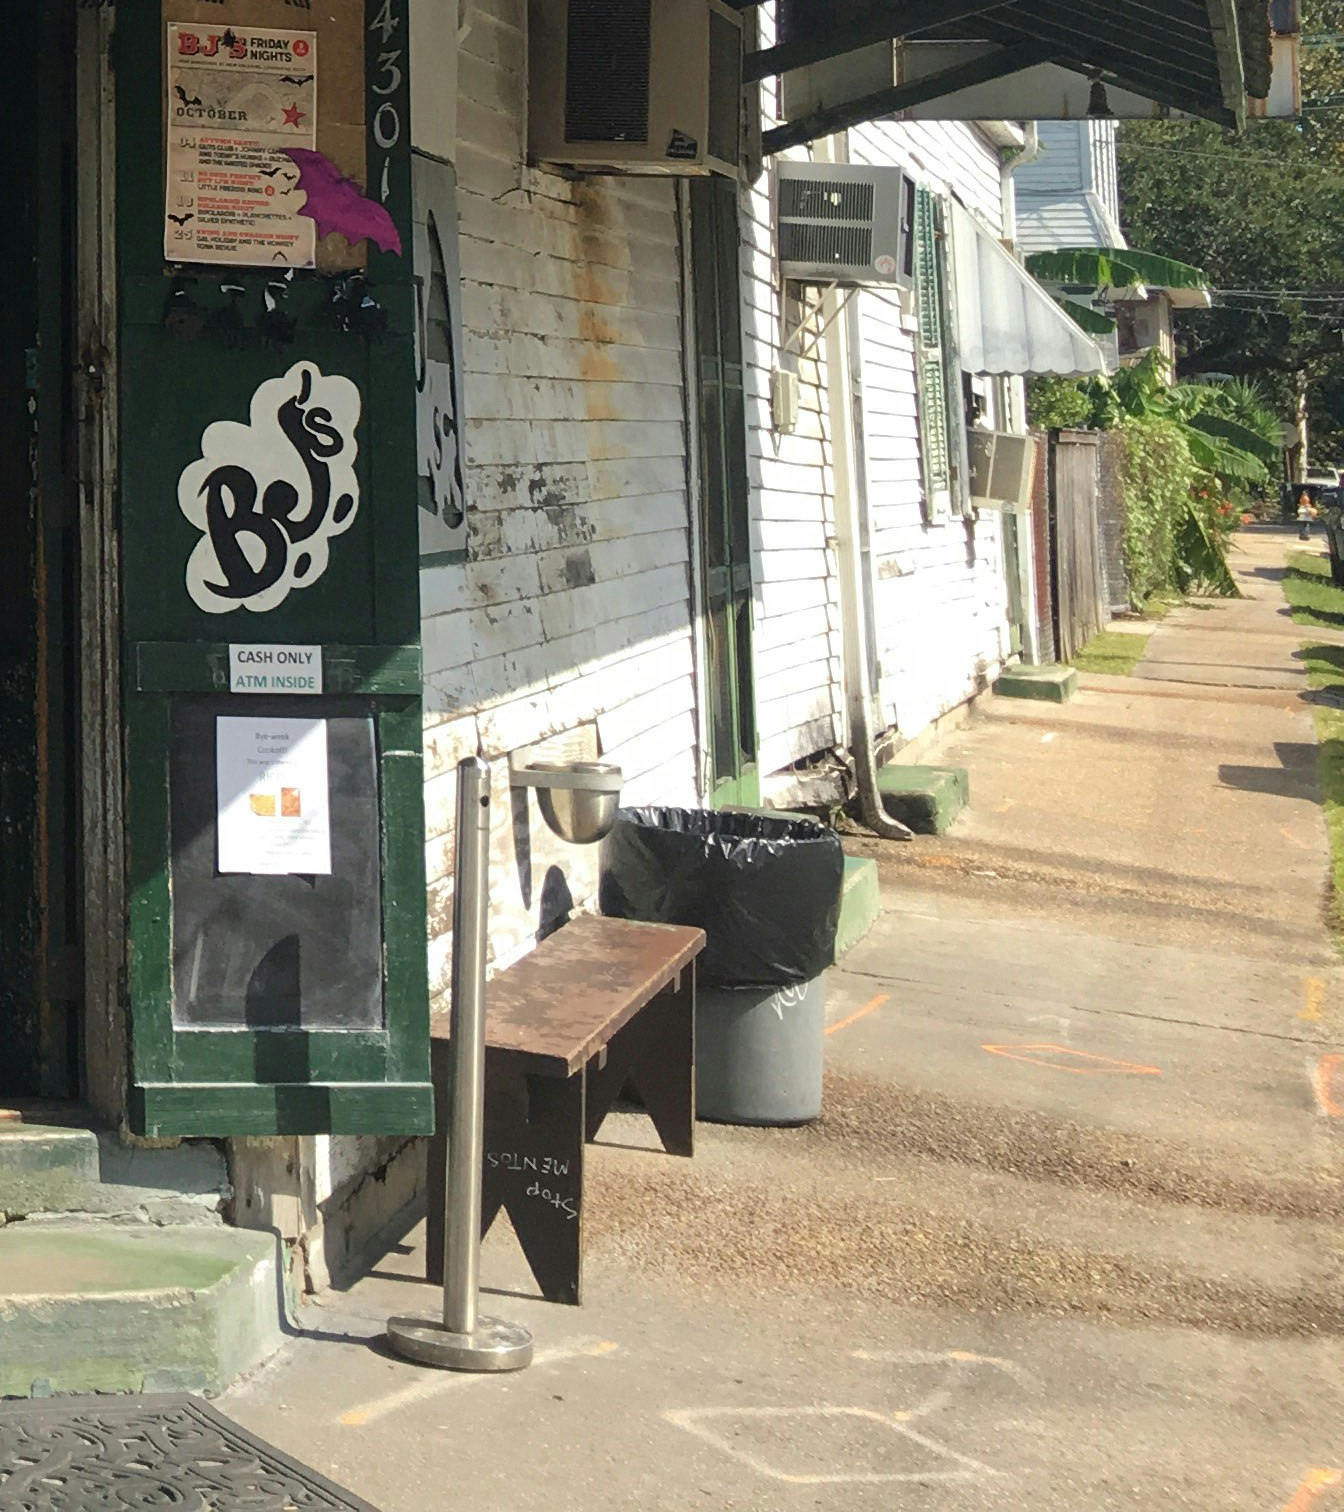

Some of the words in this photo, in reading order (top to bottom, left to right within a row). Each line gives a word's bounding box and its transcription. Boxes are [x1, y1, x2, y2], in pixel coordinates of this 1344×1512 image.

[250, 37, 290, 50] FRIDAY
[250, 49, 292, 63] NIGHTS
[176, 107, 248, 121] OCTOBER
[237, 650, 272, 663] CASH
[277, 652, 312, 664] ONLY
[236, 675, 268, 688] ATM
[272, 676, 315, 688] INSIDE
[487, 1152, 570, 1176] MENTOS
